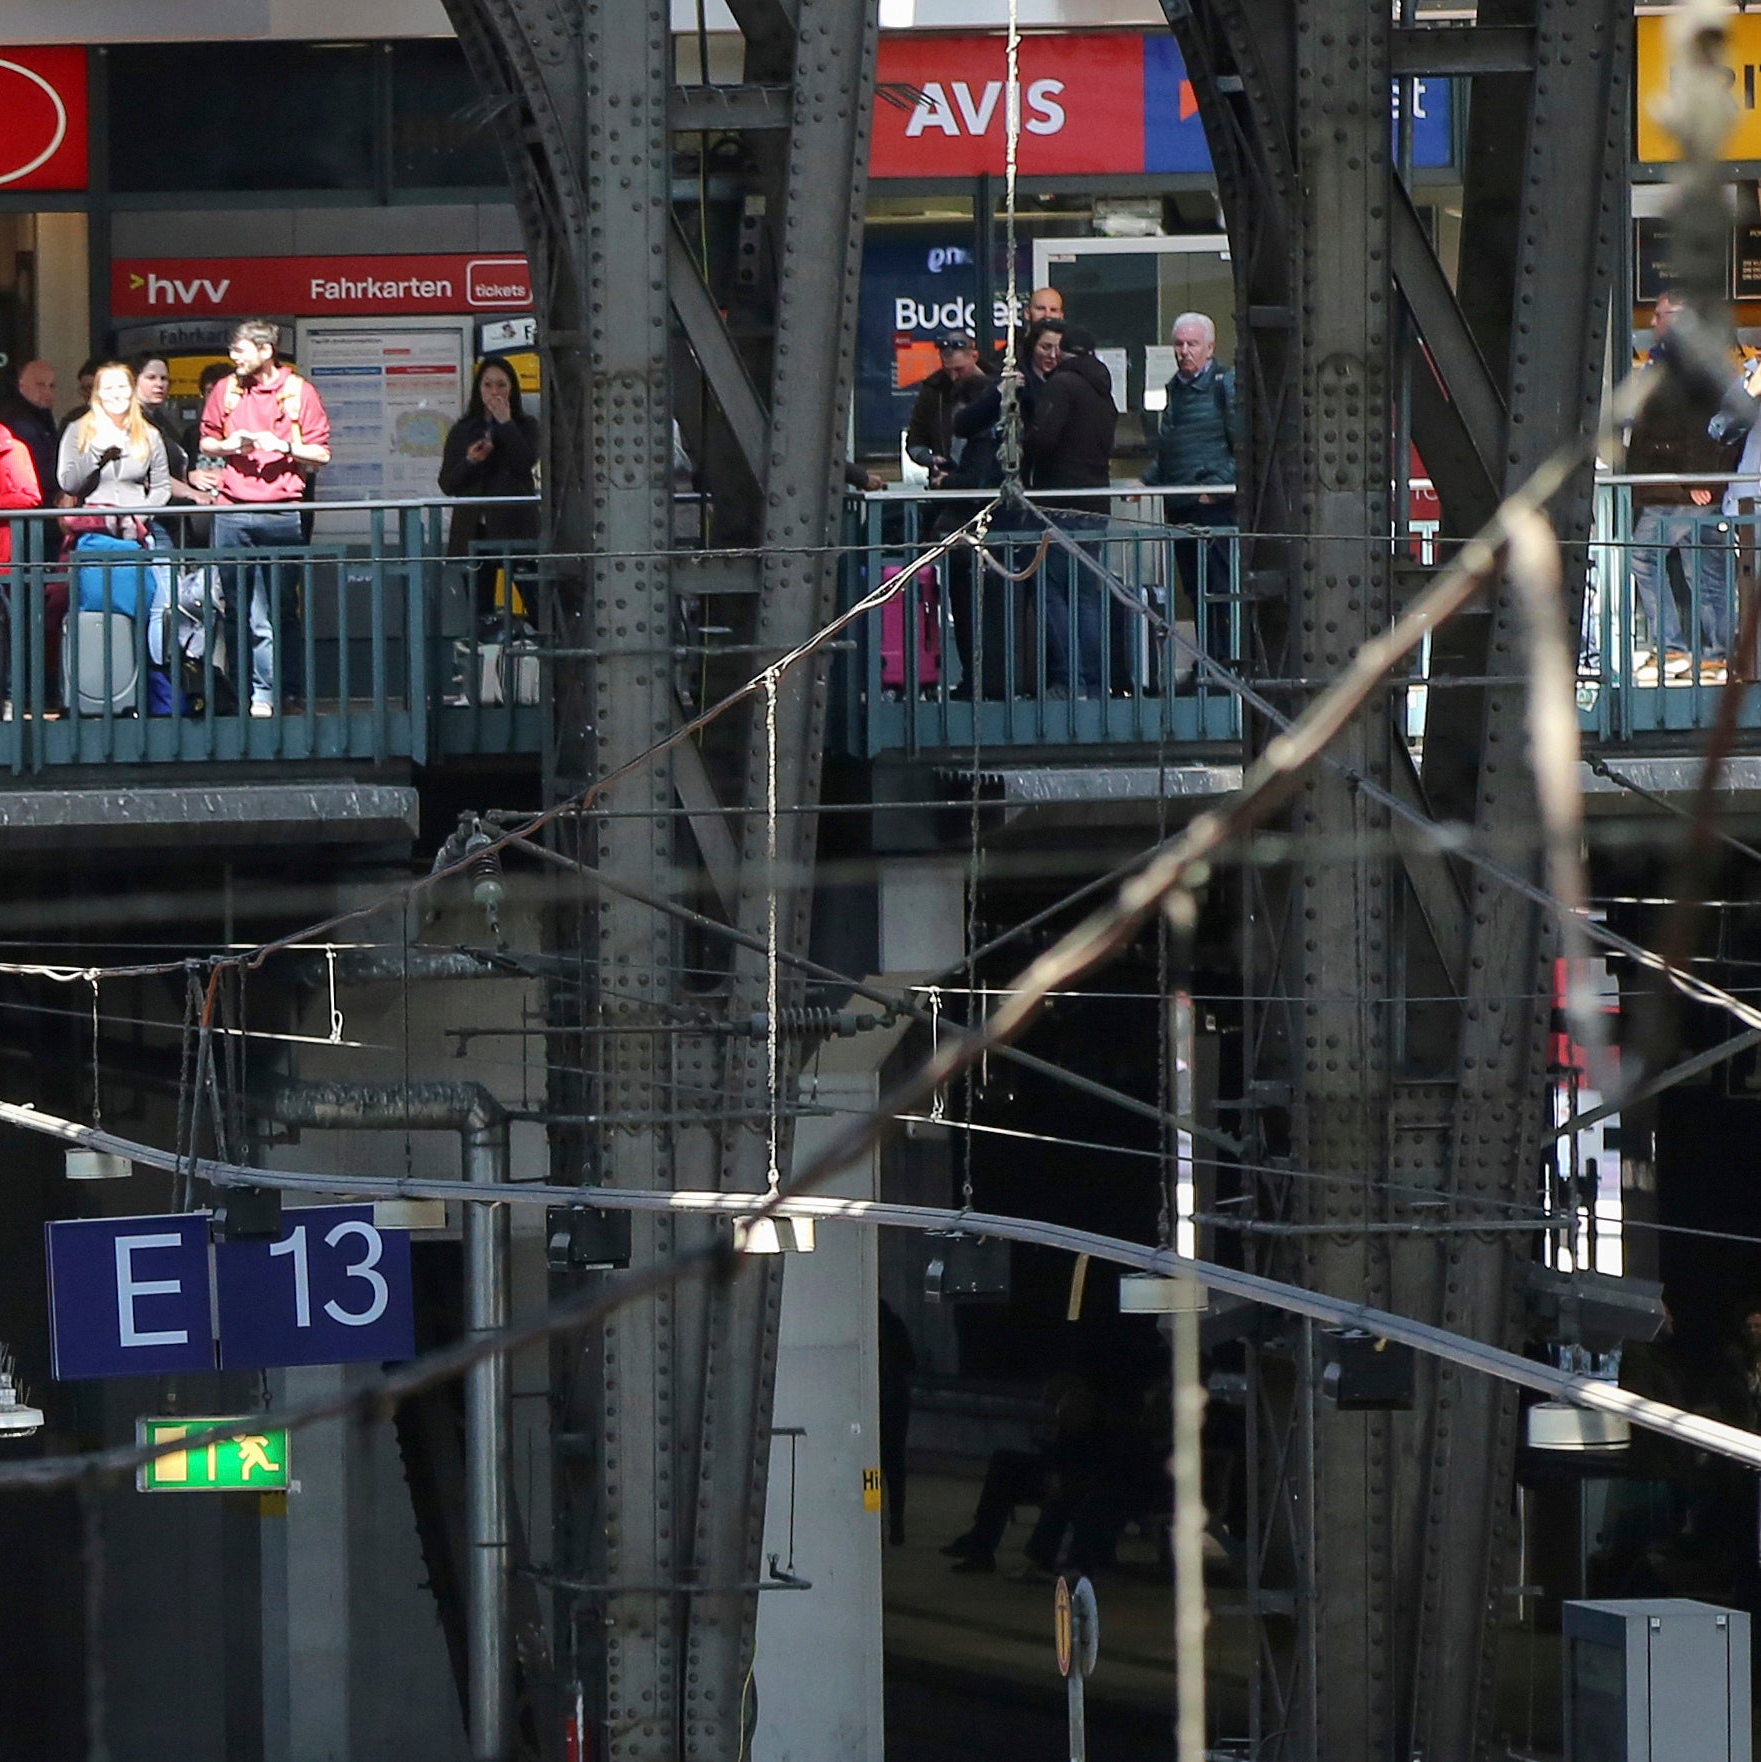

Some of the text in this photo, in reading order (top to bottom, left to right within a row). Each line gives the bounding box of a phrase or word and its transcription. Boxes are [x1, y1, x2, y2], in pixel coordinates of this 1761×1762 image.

[905, 79, 1066, 137] AVIS
[147, 273, 231, 304] hvv
[310, 277, 453, 300] Fahrkarten
[474, 282, 526, 298] tickets
[114, 1220, 389, 1347] E 13
